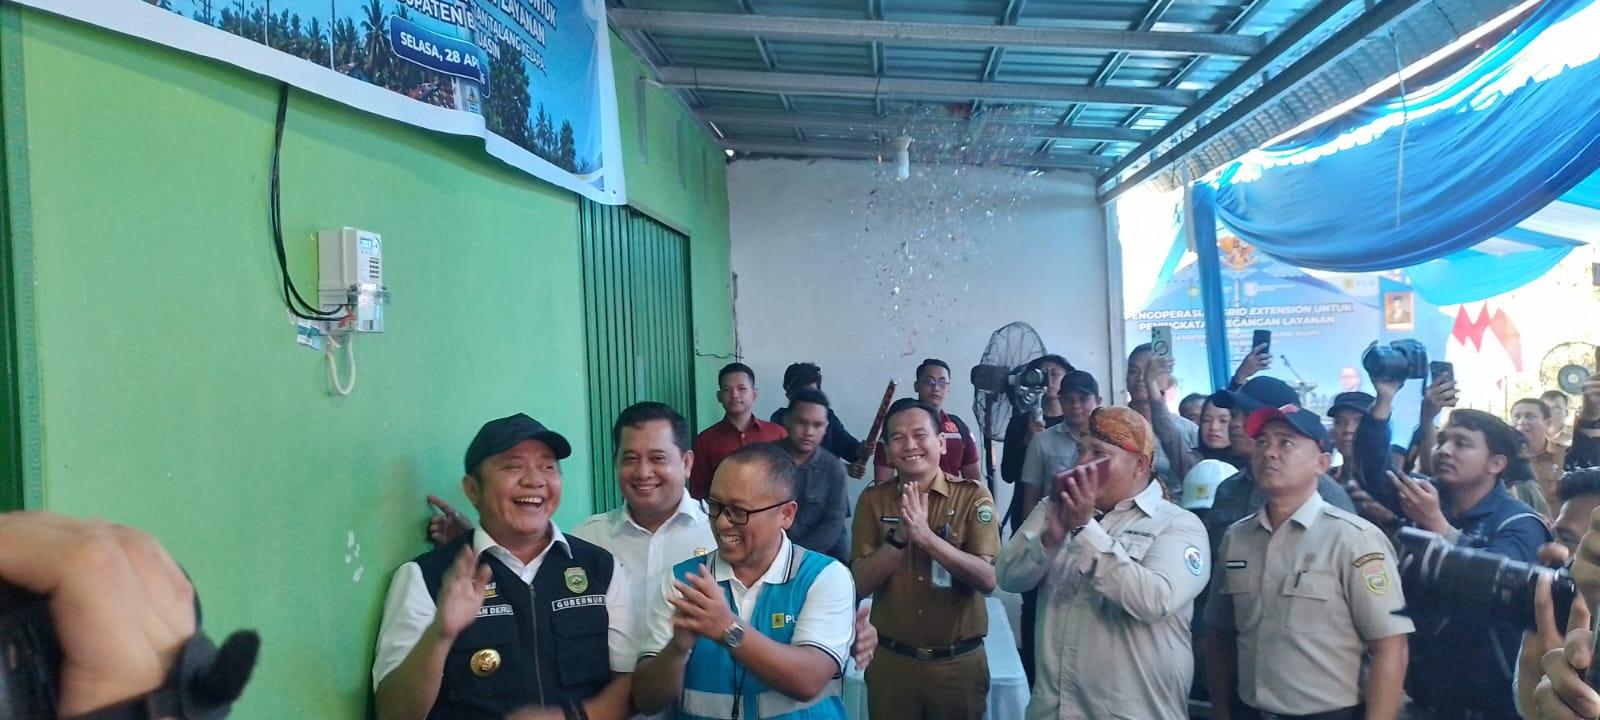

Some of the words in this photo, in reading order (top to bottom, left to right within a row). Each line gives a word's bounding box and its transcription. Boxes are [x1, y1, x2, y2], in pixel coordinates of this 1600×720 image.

[400, 31, 444, 62] SELASA,
[445, 49, 461, 64] 28
[1225, 317, 1280, 328] EGANGAN
[556, 596, 603, 608] GUBERNUR
